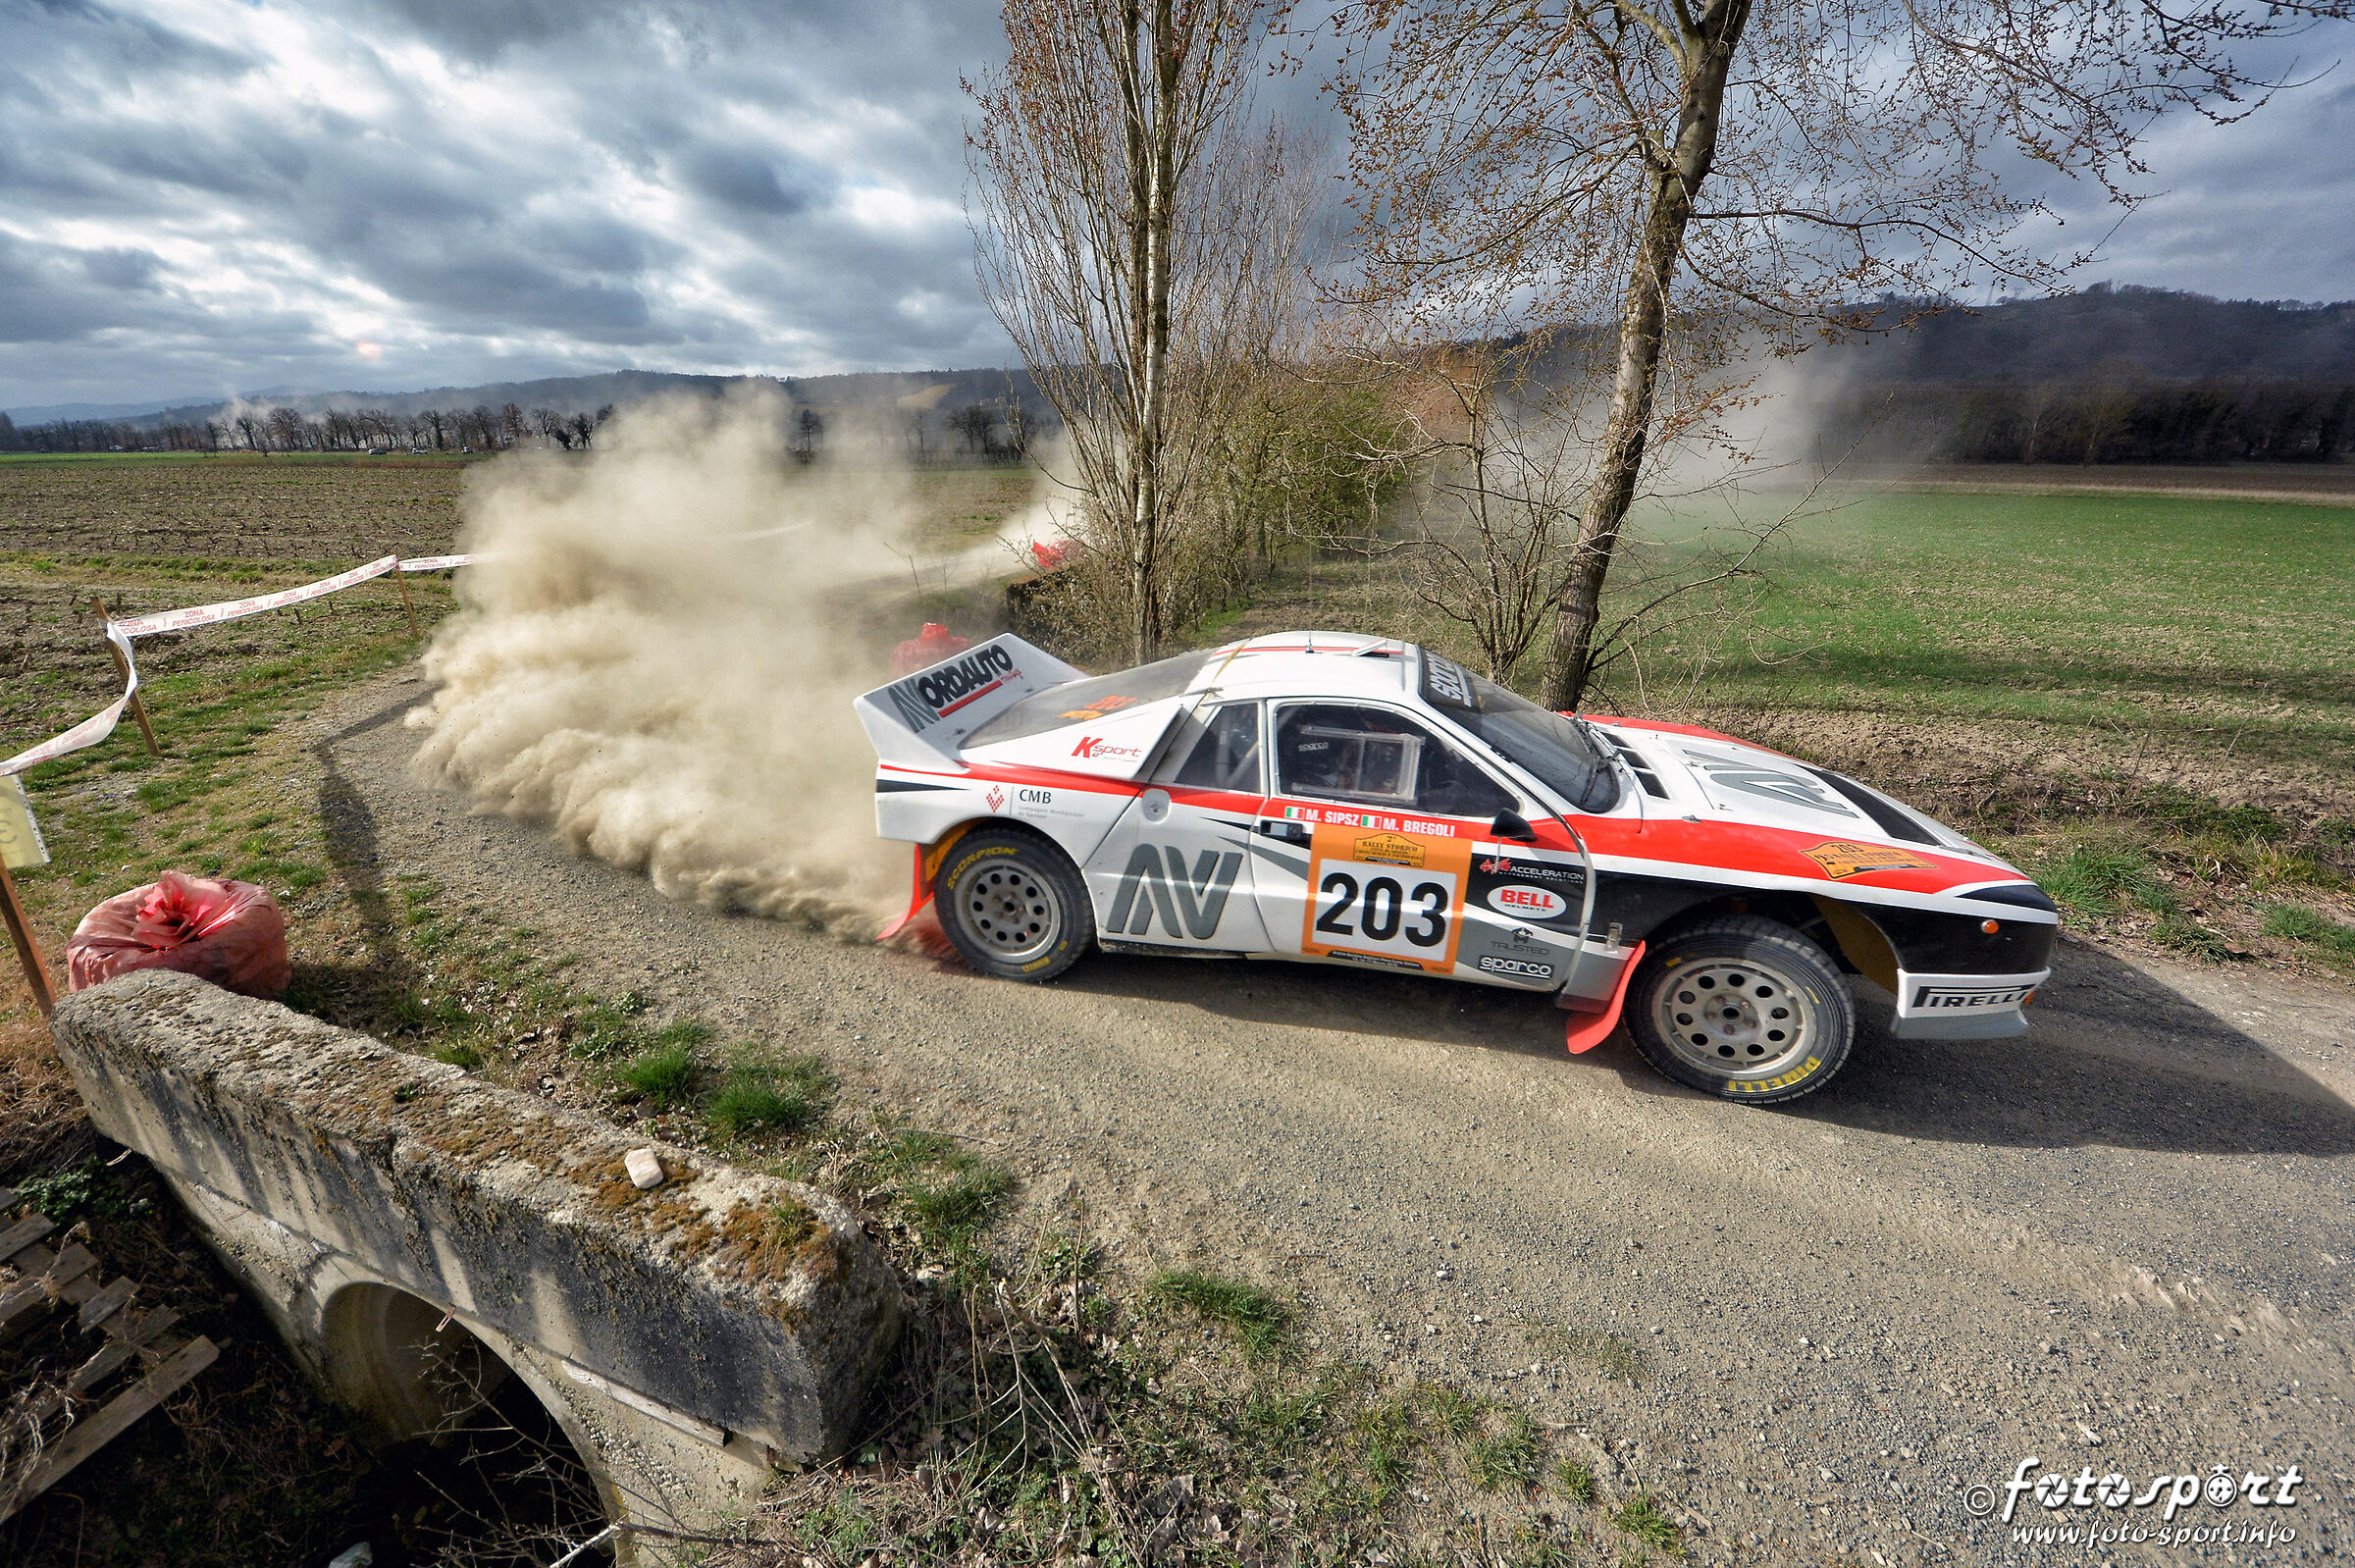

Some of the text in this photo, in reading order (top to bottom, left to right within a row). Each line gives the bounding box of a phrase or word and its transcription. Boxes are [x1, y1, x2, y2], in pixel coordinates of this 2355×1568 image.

[184, 609, 204, 618] ZONA
[227, 604, 264, 616] PERICOLOSA
[172, 614, 215, 627] PERICOLOSA
[1019, 789, 1052, 805] CMB
[1305, 810, 1322, 821] M.
[1383, 819, 1455, 837] M. BREGOLI
[947, 846, 1020, 890] SCORPION
[1510, 866, 1585, 880] ACCELERATION
[1500, 889, 1554, 909] BELL
[1316, 872, 1448, 947] 203
[1480, 957, 1552, 975] sparco
[1911, 983, 2036, 1008] PIRELLI
